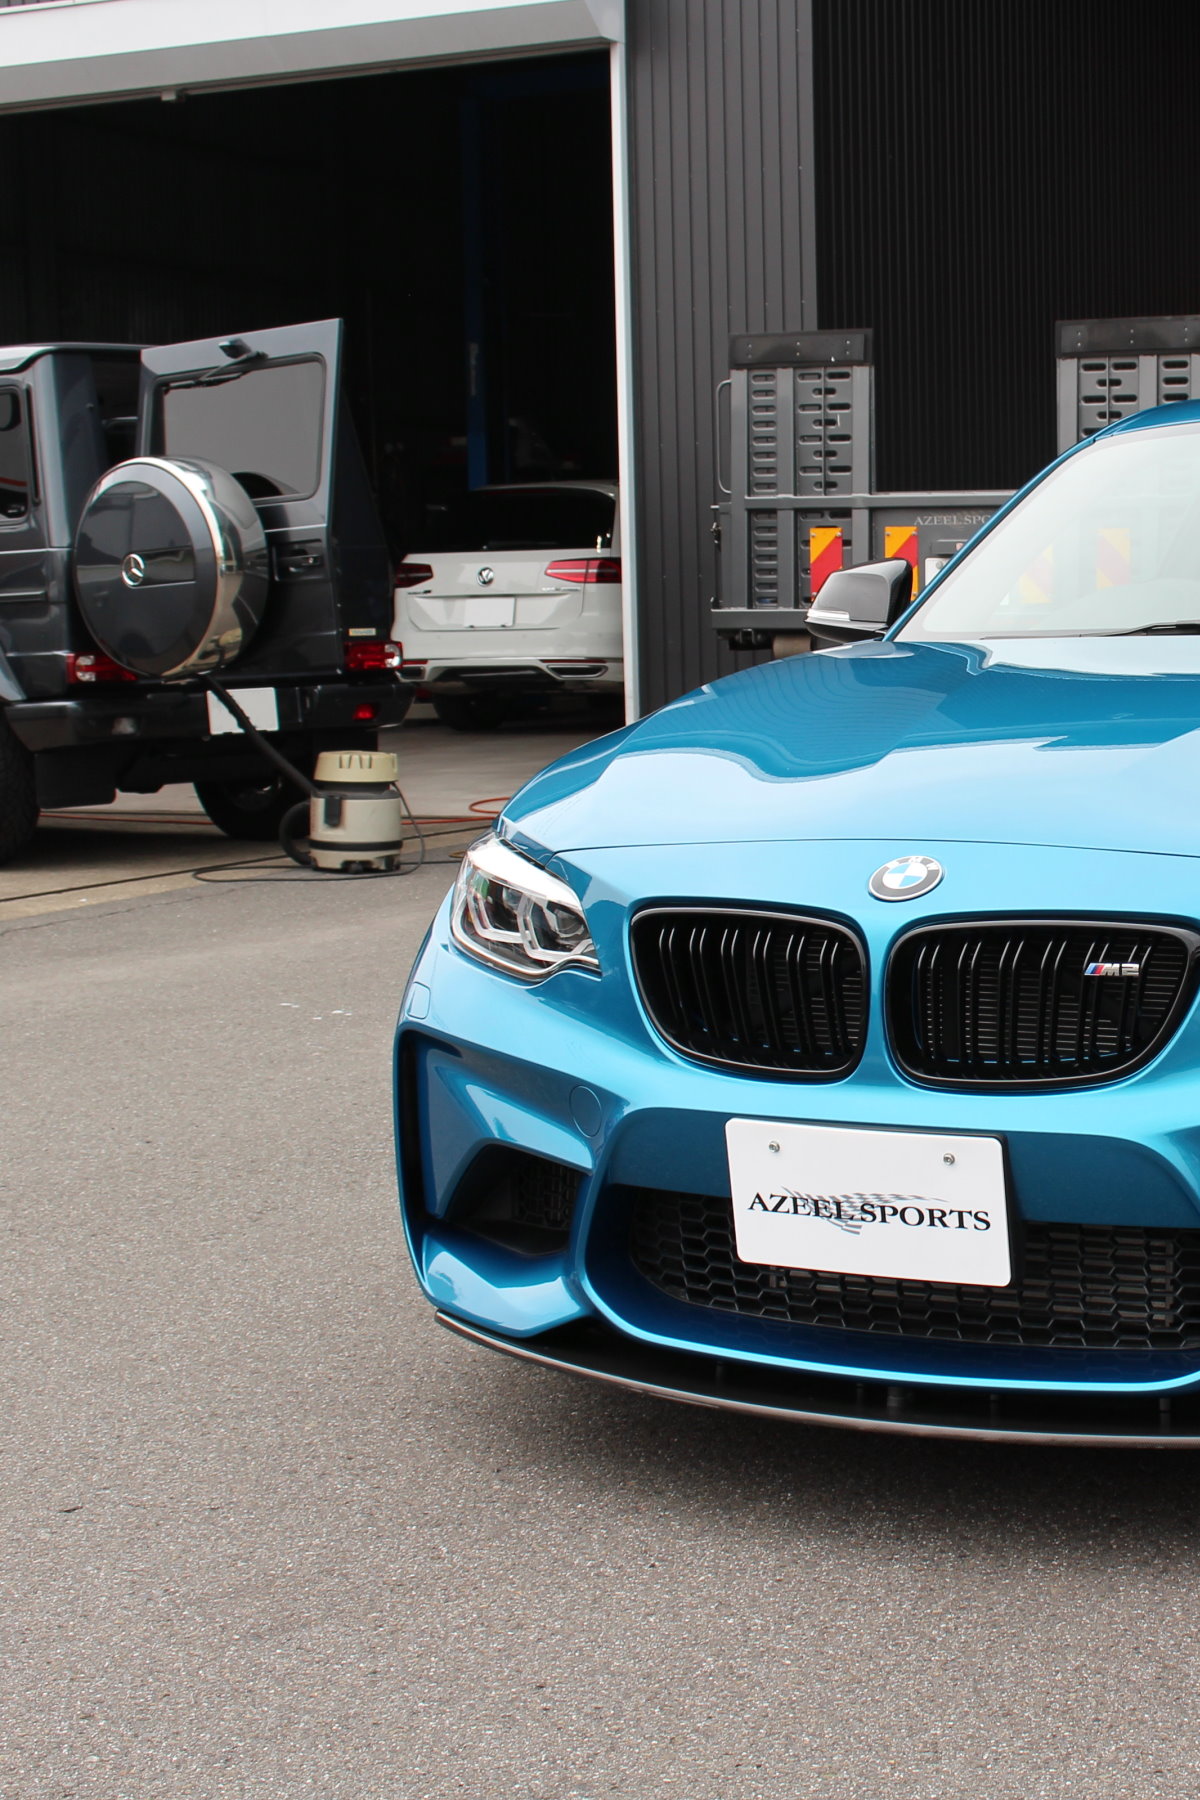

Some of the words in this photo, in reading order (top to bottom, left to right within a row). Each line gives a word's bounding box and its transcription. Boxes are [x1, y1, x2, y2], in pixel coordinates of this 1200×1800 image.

[914, 515, 962, 526] AZEEL
[1100, 962, 1140, 977] M2
[747, 1191, 855, 1221] AZEEL
[859, 1202, 992, 1231] SPORTS
